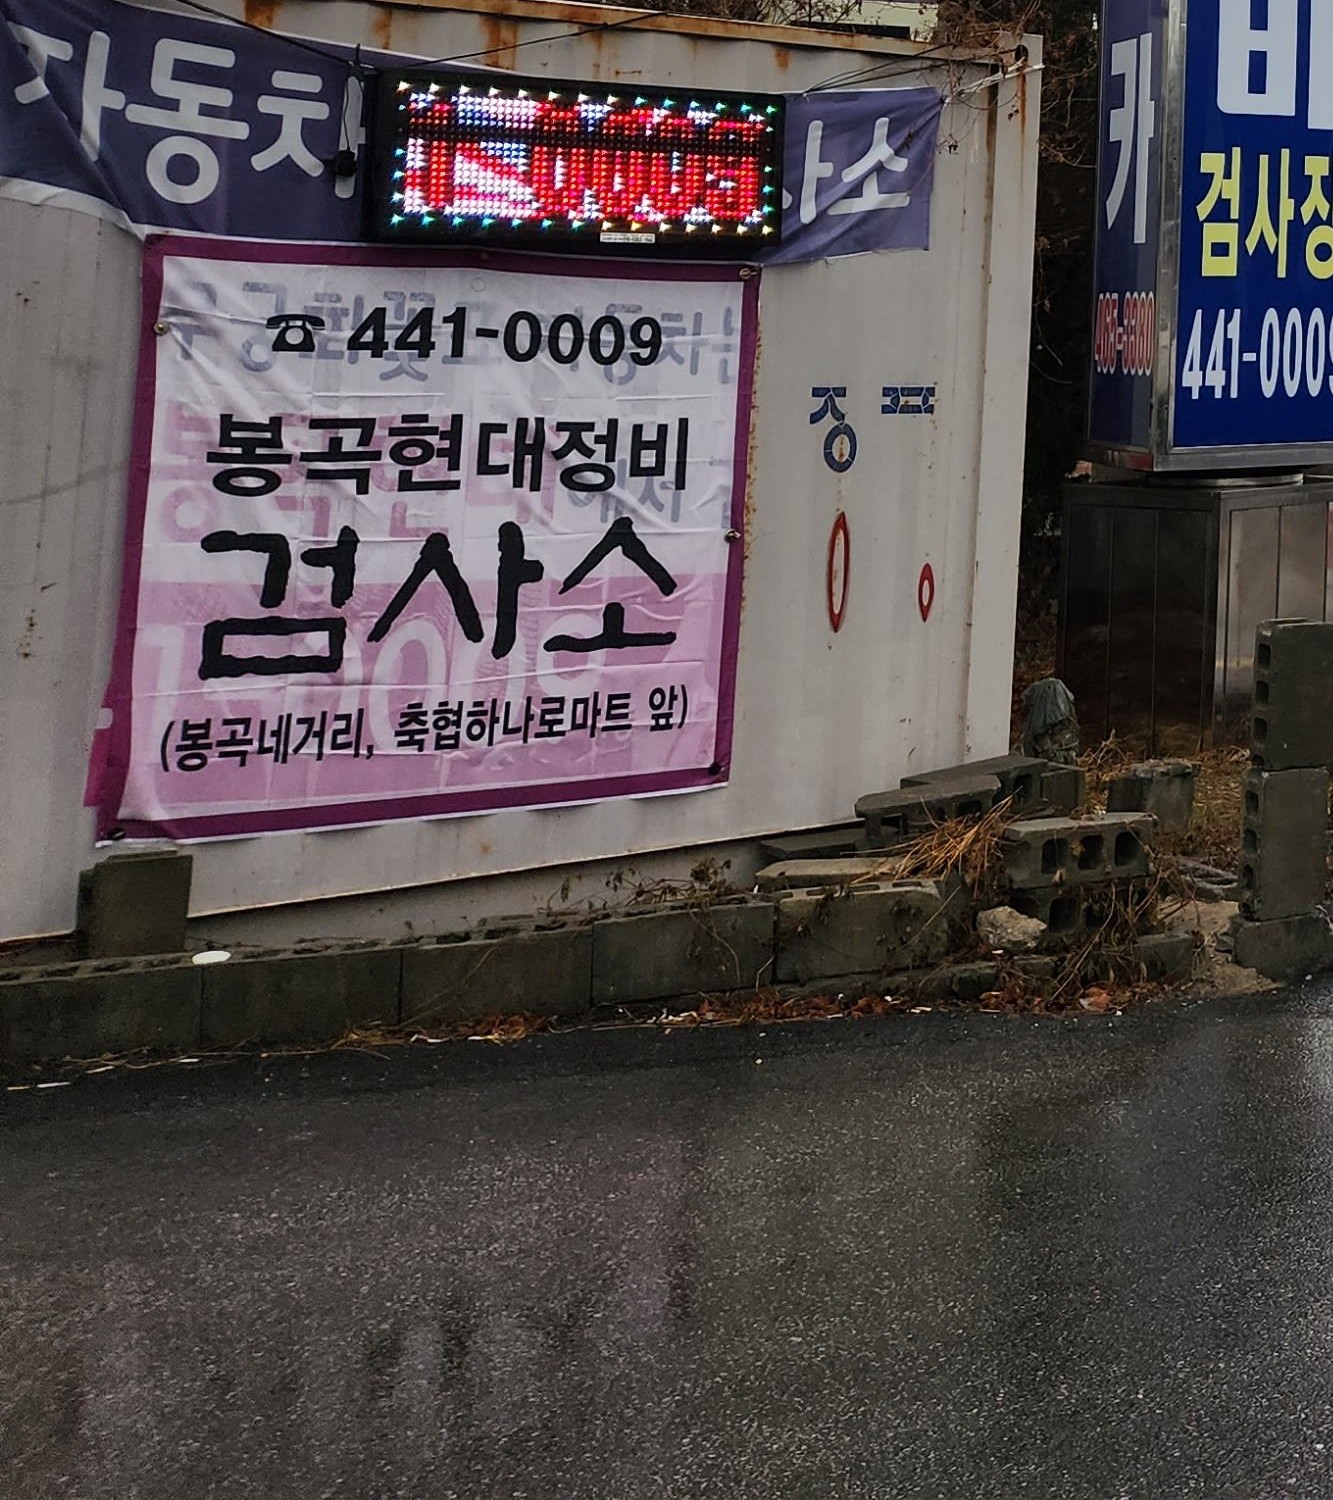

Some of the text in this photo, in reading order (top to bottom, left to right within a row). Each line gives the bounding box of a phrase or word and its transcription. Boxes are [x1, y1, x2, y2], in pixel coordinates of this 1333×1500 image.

[347, 306, 663, 367] 441-0009
[206, 411, 690, 498] 봉곡현대정비
[200, 517, 678, 680] 검사소
[160, 683, 688, 773] (봉곡네거리, 축협하나로마트 앞)
